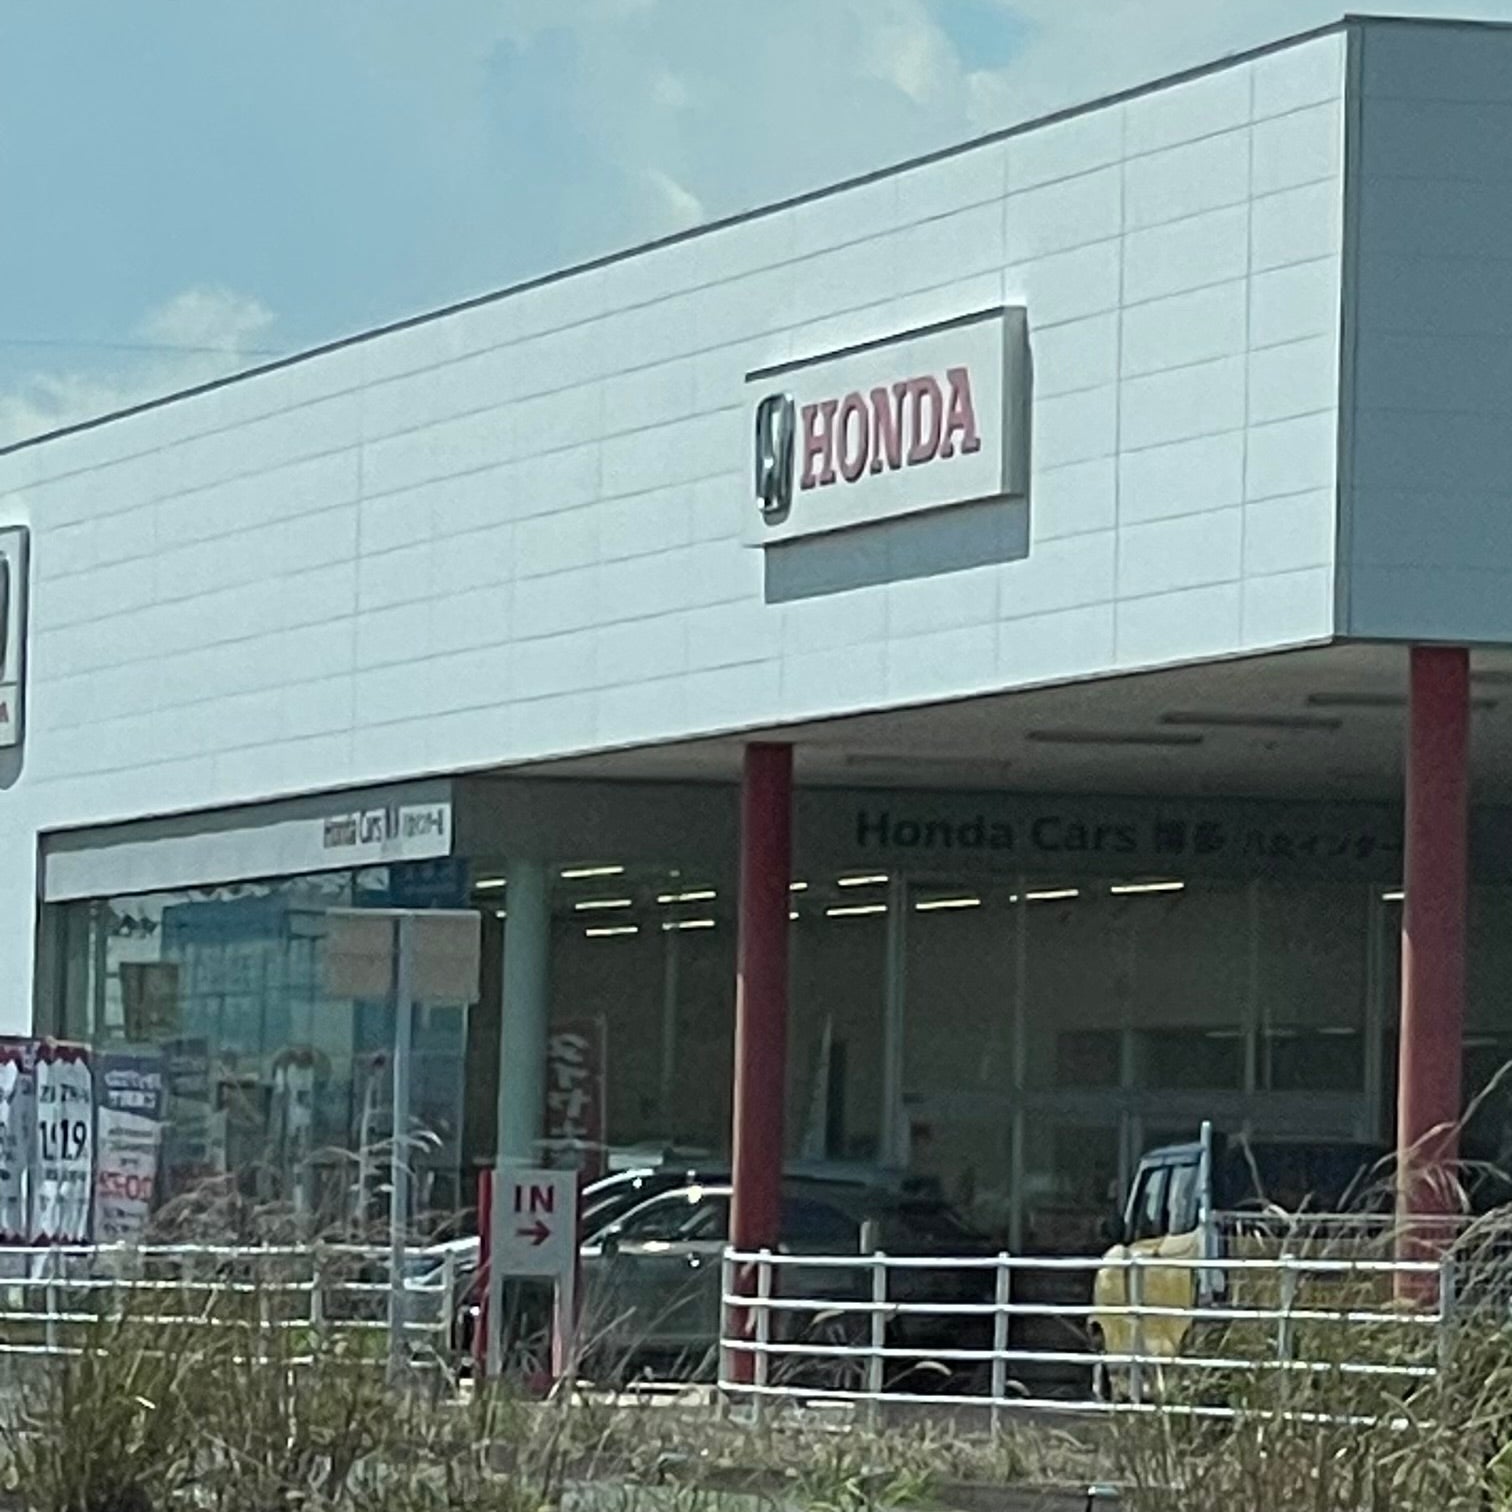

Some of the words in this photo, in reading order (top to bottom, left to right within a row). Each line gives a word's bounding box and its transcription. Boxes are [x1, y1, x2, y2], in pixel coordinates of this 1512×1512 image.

[799, 366, 982, 491] HONDA
[857, 811, 1013, 850] Honda
[1031, 816, 1138, 853] Cars
[514, 1185, 554, 1214] IN
